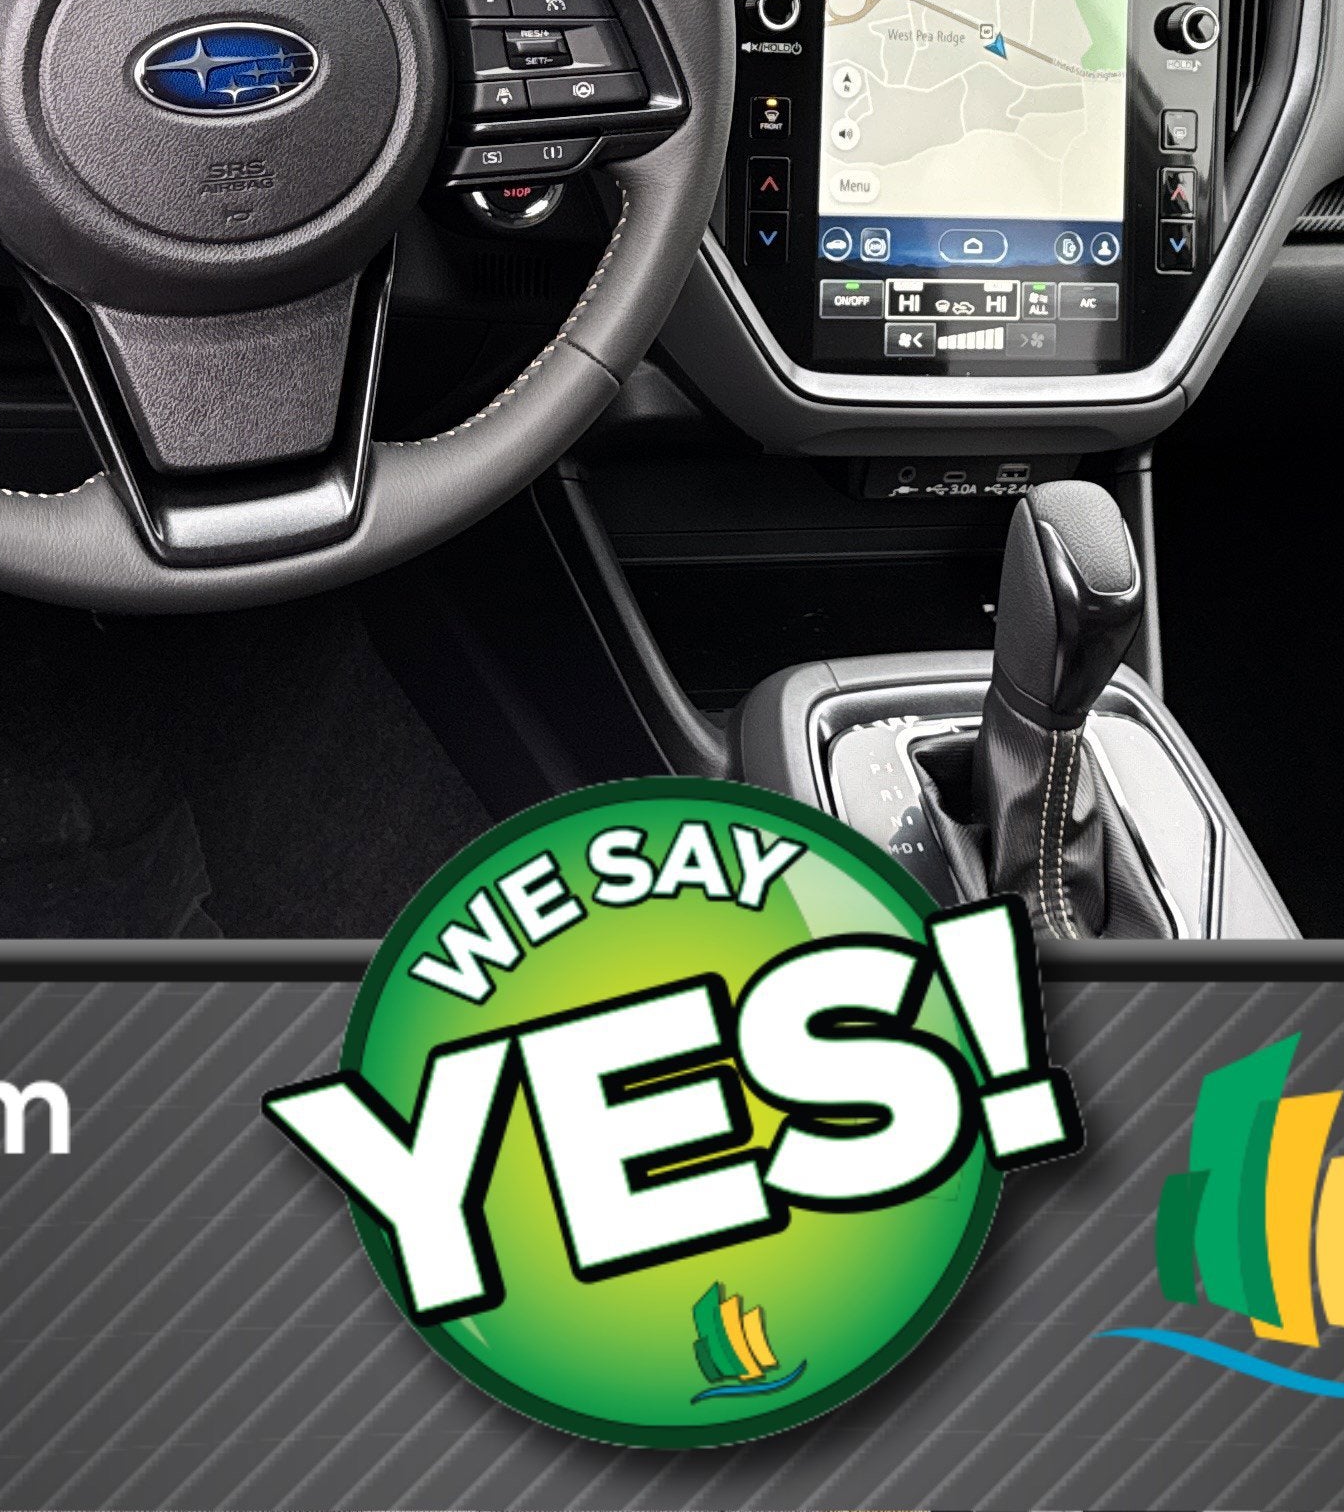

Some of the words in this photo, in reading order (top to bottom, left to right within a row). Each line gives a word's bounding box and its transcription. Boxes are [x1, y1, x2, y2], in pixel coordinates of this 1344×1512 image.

[888, 28, 913, 42] West
[937, 30, 966, 44] Ridge
[762, 43, 792, 54] HOLD
[759, 122, 784, 130] FRONT
[208, 161, 266, 179] SRS
[839, 178, 871, 192] Menu
[503, 187, 532, 197] STOP
[834, 295, 870, 306] ON/OFF
[898, 295, 920, 313] HI
[986, 295, 1007, 313] HI
[1079, 298, 1097, 309] A/C
[1029, 305, 1049, 316] ALL
[949, 484, 977, 495] 3.0A
